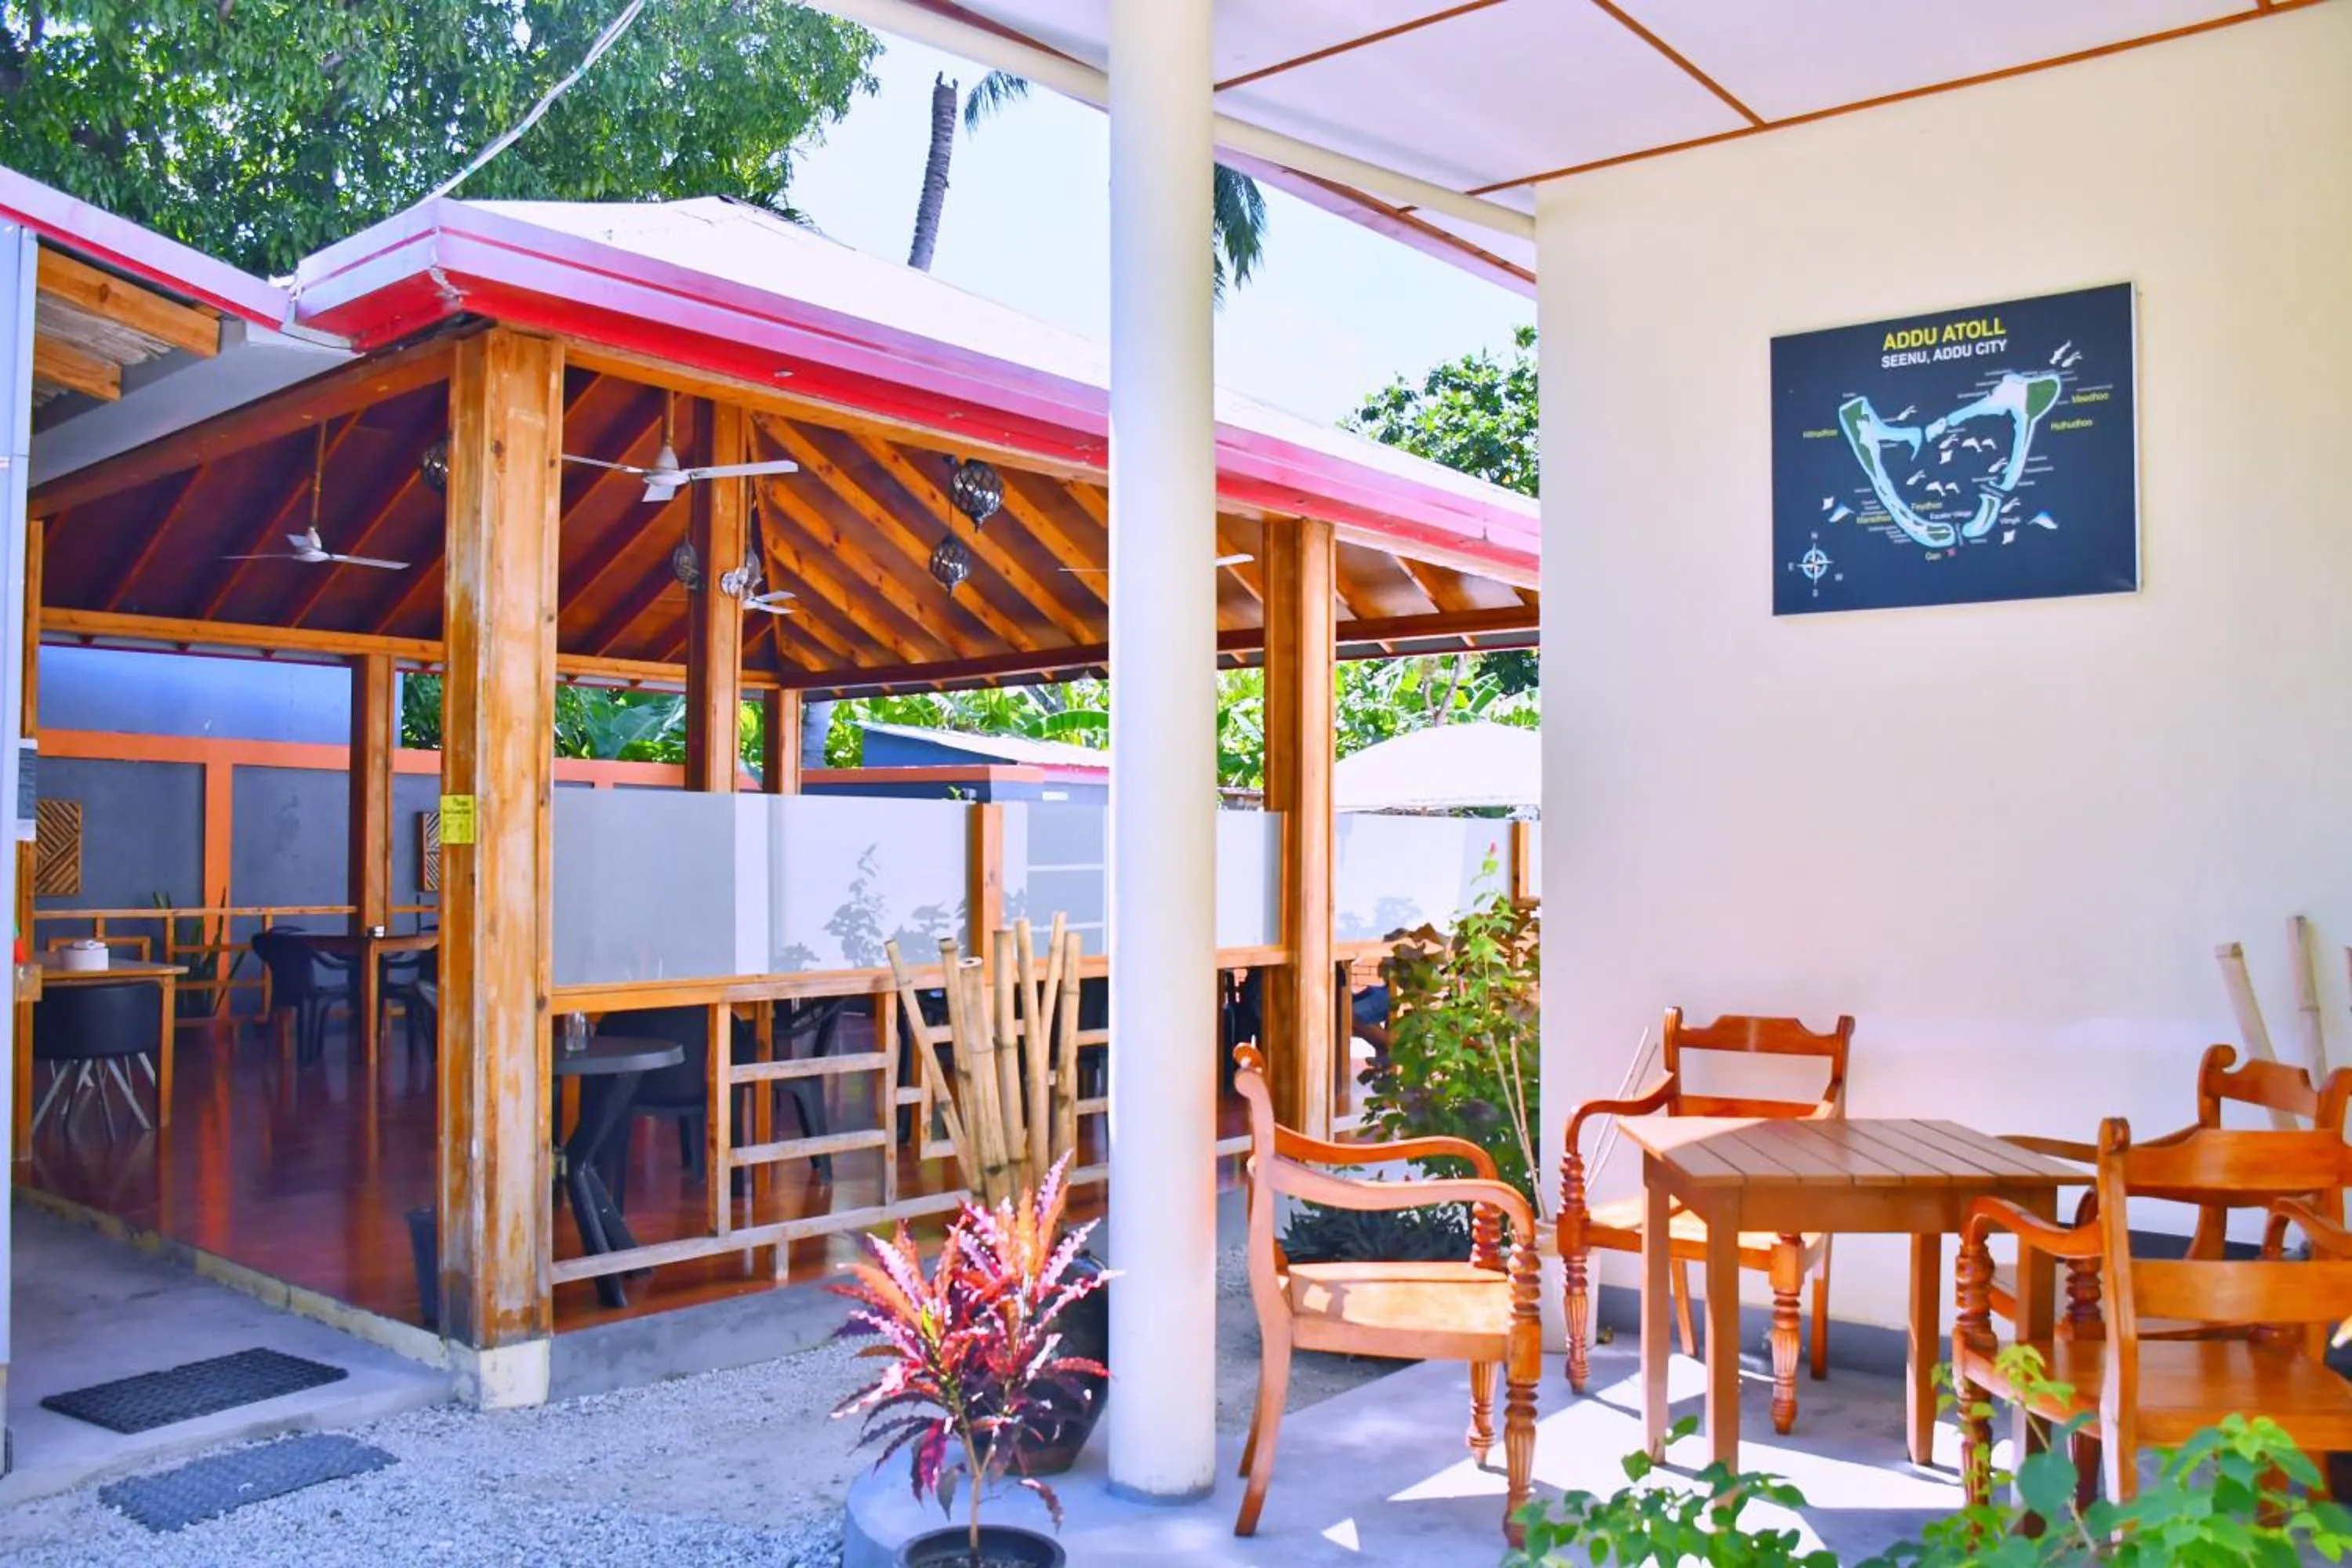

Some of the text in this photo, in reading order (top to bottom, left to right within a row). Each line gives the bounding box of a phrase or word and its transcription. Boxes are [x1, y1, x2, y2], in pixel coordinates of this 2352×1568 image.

[1882, 317, 2007, 351] ADDU ATOLL
[1881, 339, 2008, 368] SEENU, ADDU CITY
[1925, 552, 1942, 561] Gan
